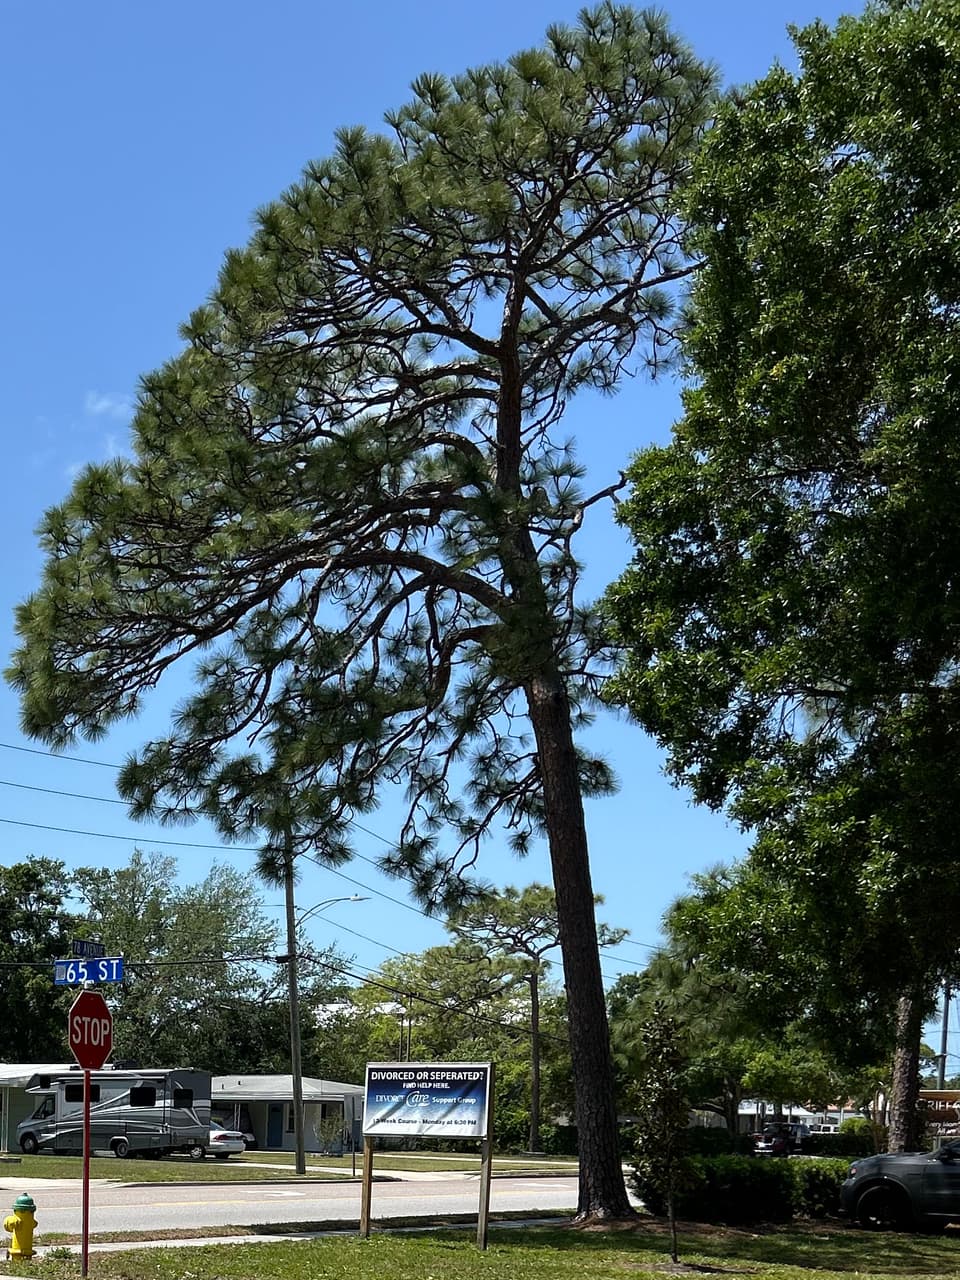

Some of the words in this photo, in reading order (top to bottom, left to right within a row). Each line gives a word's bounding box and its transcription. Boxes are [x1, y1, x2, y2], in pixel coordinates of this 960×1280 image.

[66, 962, 88, 984] 65
[98, 960, 119, 981] ST
[72, 1016, 110, 1046] STOP
[371, 1071, 414, 1080] DIVORCED
[416, 1072, 429, 1080] OR
[430, 1071, 484, 1080] SEPERATED?
[432, 1096, 456, 1104] Support
